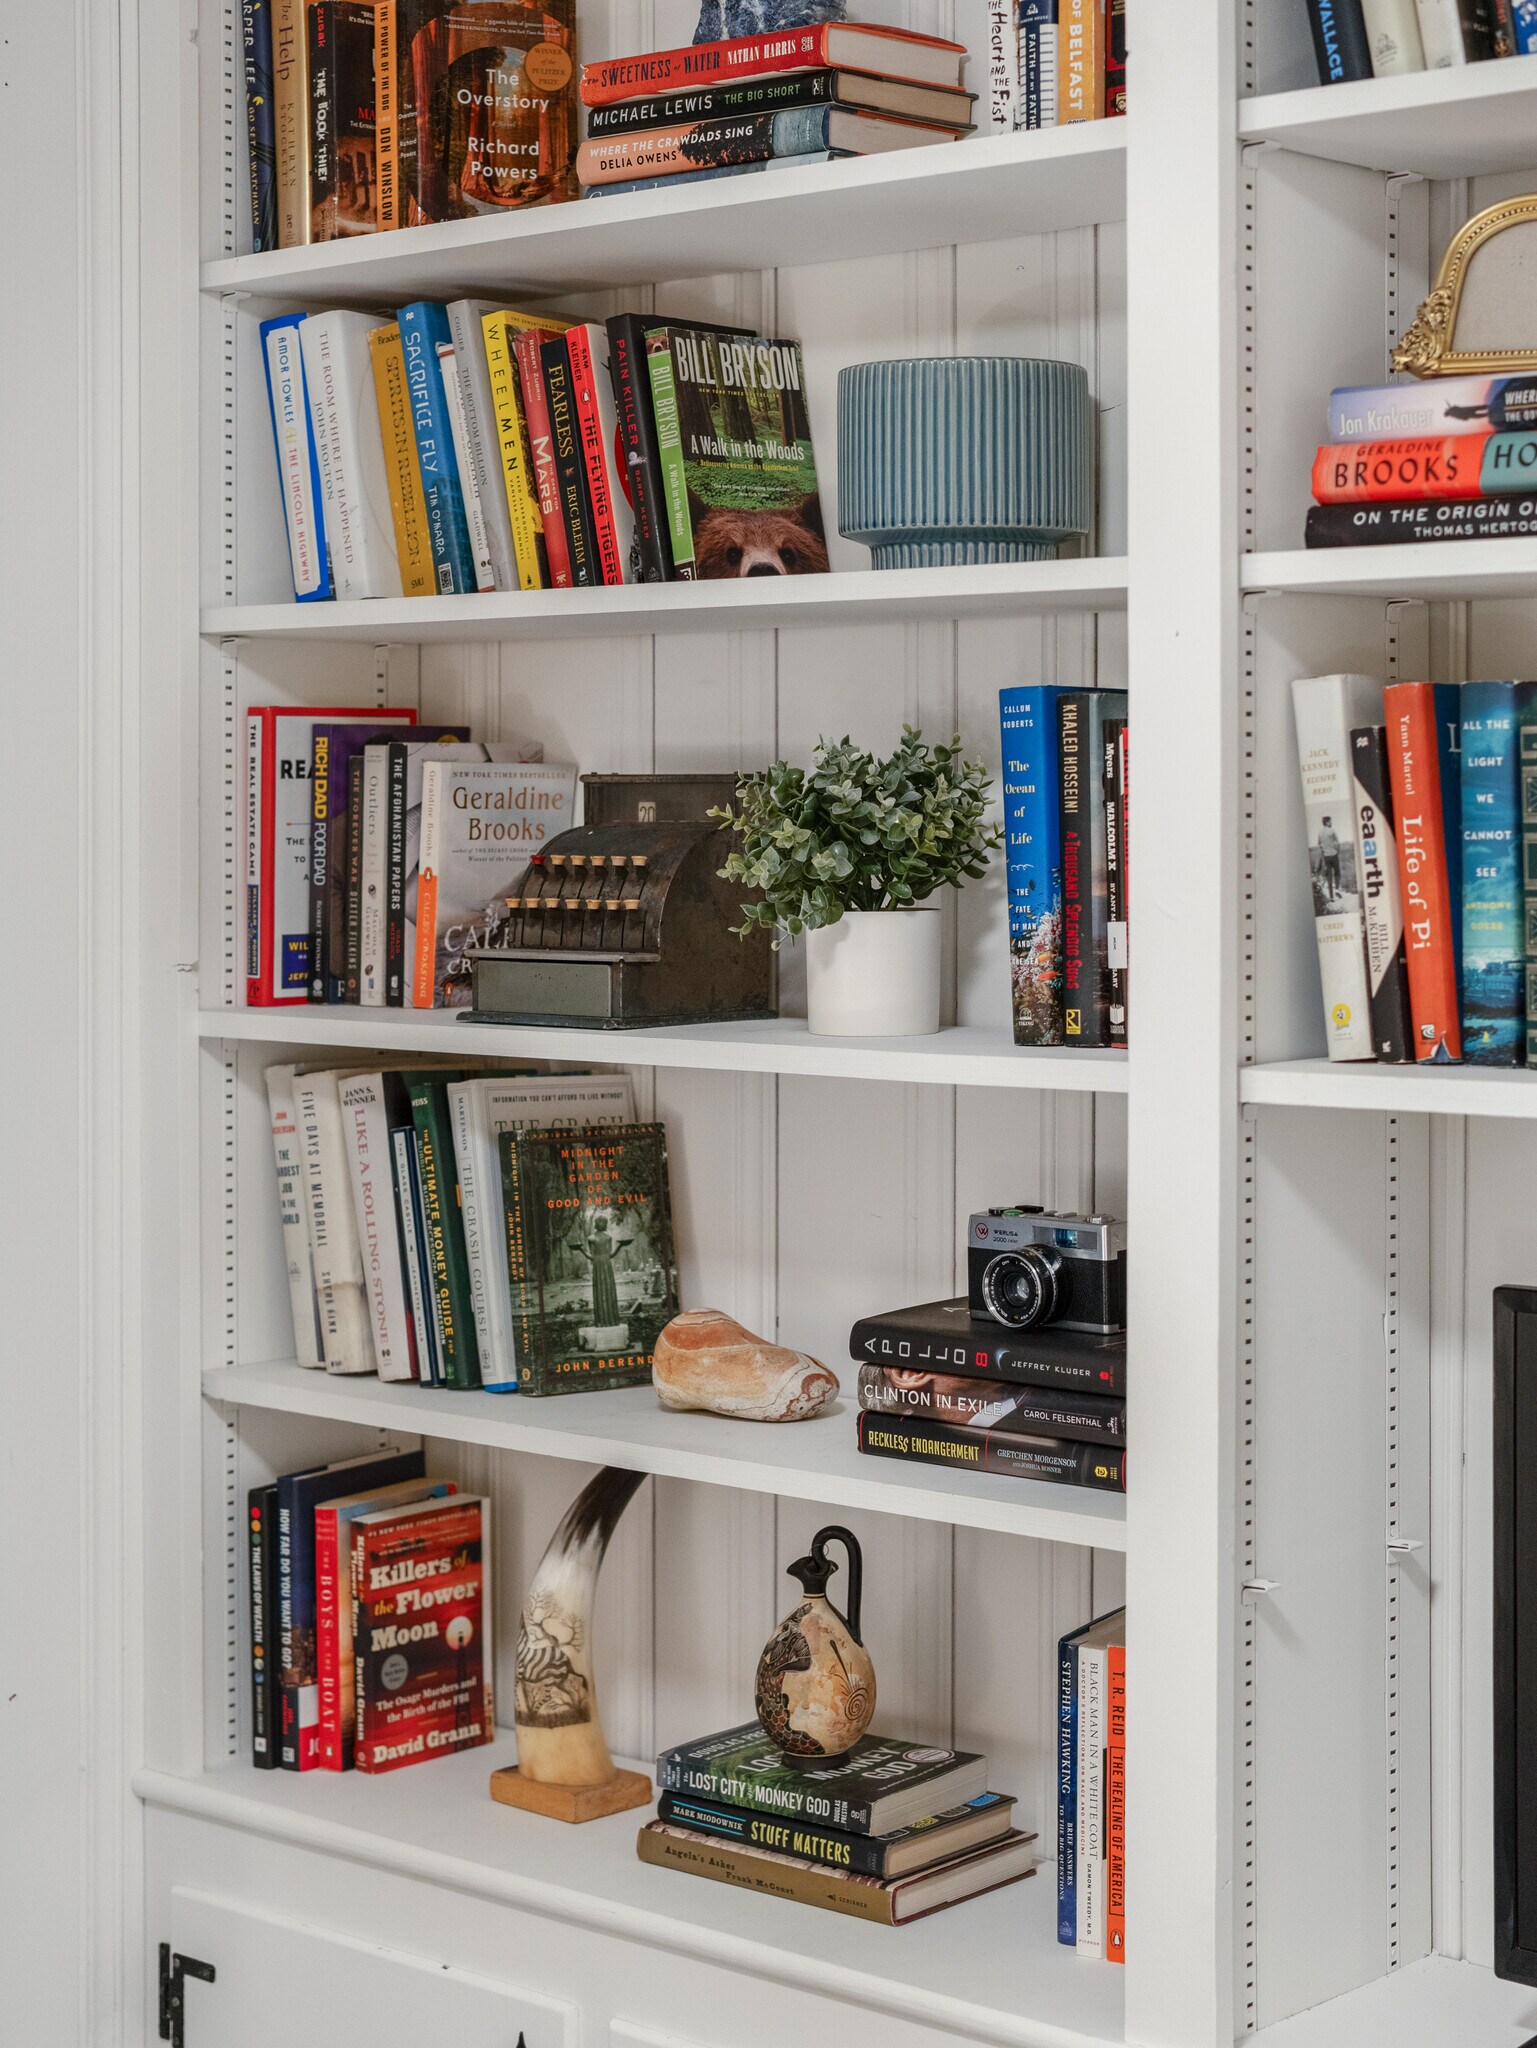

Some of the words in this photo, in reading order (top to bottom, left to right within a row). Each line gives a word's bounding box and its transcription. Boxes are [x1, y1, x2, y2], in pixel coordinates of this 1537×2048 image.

[276, 24, 296, 81] Help
[601, 58, 672, 88] SWEETNESS
[684, 51, 720, 74] WATER
[727, 46, 760, 66] NATHAN
[763, 40, 796, 58] HARRIS
[1070, 24, 1082, 110] BELFAST
[486, 68, 520, 85] The
[457, 89, 550, 113] Overstory
[593, 105, 658, 128] MICHAEL
[665, 95, 713, 116] LEWIS
[724, 93, 744, 105] THE
[747, 89, 764, 102] BIG
[767, 84, 800, 98] SHORT
[468, 136, 540, 156] Richard
[590, 142, 628, 158] WHERE
[632, 140, 654, 152] THE
[657, 130, 722, 149] CRAWDADS
[725, 126, 754, 140] SING
[471, 161, 538, 180] Powers
[600, 158, 633, 171] DELIA
[636, 151, 678, 166] OWENS
[250, 162, 260, 225] WATCHMAN
[278, 336, 290, 373] AMOR
[570, 342, 582, 381] KLEINER
[580, 348, 588, 368] SAM
[675, 336, 715, 385] BILL
[718, 342, 800, 390] BRYSON
[405, 332, 432, 430] SACRIFICE
[282, 378, 294, 423] TOWLES
[488, 324, 518, 472] WHEELMEN
[548, 364, 574, 458] FEARLESS
[584, 413, 598, 448] THE
[1339, 414, 1363, 436] Jon
[1368, 406, 1434, 432] Krakauer
[288, 448, 298, 467] THE
[420, 440, 438, 472] FLY
[691, 434, 698, 454] A
[700, 436, 728, 456] Walk
[730, 439, 742, 457] in
[744, 440, 764, 458] the
[765, 440, 805, 460] Woods
[1357, 441, 1443, 457] GERALDINE
[590, 455, 608, 516] FLYING
[1334, 456, 1458, 488] BROOKS
[291, 474, 304, 526] LINCOLN
[428, 486, 438, 507] TIM
[567, 486, 579, 516] ERIC
[1353, 512, 1381, 526] ON
[1390, 508, 1429, 522] THE
[1436, 502, 1510, 520] ORIGIN
[1414, 524, 1474, 538] THOMAS
[1480, 520, 1537, 534] HERTOG
[432, 510, 445, 556] O'MARA
[572, 518, 586, 564] BLEHM
[298, 532, 310, 582] HIGHWAY
[600, 522, 618, 584] TIGERS
[1003, 720, 1034, 728] ROBERTS
[1004, 704, 1031, 714] CALLUM
[1463, 721, 1482, 730] ALL
[1486, 719, 1510, 730] THE
[1062, 704, 1078, 753] KHALED
[1400, 715, 1410, 748] Yann
[315, 737, 328, 776] RICH
[394, 758, 402, 778] THE
[1008, 760, 1030, 772] The
[1468, 756, 1503, 767] LIGHT
[1005, 783, 1036, 794] Ocean
[1064, 758, 1079, 814] HOSSEINI
[1402, 751, 1415, 796] Martel
[315, 780, 328, 819] DAD
[453, 786, 564, 810] Geraldine
[1014, 806, 1026, 818] of
[1476, 794, 1494, 804] WE
[314, 822, 326, 856] POOR
[392, 784, 402, 862] AFGHANISTAN
[468, 817, 546, 840] Brooks
[1010, 832, 1032, 845] Life
[1464, 830, 1512, 840] CANNOT
[1360, 805, 1384, 898] eaarth
[1403, 815, 1426, 873] Life
[314, 858, 326, 886] DAD
[1064, 841, 1080, 899] THOUSAND
[1476, 868, 1497, 878] SEE
[392, 867, 400, 910] PAPERS
[1408, 881, 1427, 910] of
[1065, 904, 1082, 957] SPLENDID
[1412, 918, 1431, 949] Pi
[1066, 960, 1082, 990] SUNS
[558, 1094, 578, 1102] AFFORD
[601, 1092, 622, 1100] WITHOUT
[562, 1146, 624, 1158] MIDNIGHT
[572, 1162, 584, 1170] IN
[592, 1158, 614, 1168] THE
[568, 1172, 620, 1182] GARDEN
[587, 1185, 602, 1194] OF
[548, 1199, 580, 1208] GOOD
[587, 1196, 610, 1206] AND
[618, 1193, 648, 1204] EVIL
[433, 1226, 448, 1280] MONEY
[993, 1236, 1007, 1244] 2000
[440, 1288, 454, 1336] GUIDE
[556, 1362, 590, 1373] JOHN
[864, 1336, 966, 1366] APOLLO
[976, 1352, 988, 1367] 8
[1012, 1360, 1050, 1371] JEFFREY
[1054, 1366, 1091, 1377] KLUGER
[864, 1384, 930, 1408] CLINTON
[936, 1394, 952, 1408] IN
[957, 1397, 1002, 1416] EXILE
[1024, 1409, 1050, 1421] CAROL
[1052, 1412, 1102, 1428] FELSENTHAL
[911, 1436, 980, 1462] ENDANGERMENT
[997, 1449, 1033, 1462] GRETCHEN
[1034, 1453, 1077, 1467] MORGENSON
[370, 1557, 452, 1590] Killers
[454, 1550, 468, 1568] of
[374, 1601, 394, 1616] the
[396, 1582, 478, 1616] Flower
[370, 1621, 438, 1652] Moon
[1062, 1661, 1072, 1722] STEPHEN
[1090, 1662, 1098, 1704] BLACK
[1090, 1708, 1098, 1738] MAN
[1112, 1705, 1124, 1736] REID
[373, 1732, 424, 1764] David
[426, 1722, 482, 1748] Grann
[1090, 1744, 1098, 1758] IN
[1061, 1728, 1071, 1794] HAWKING
[1112, 1756, 1123, 1776] THE
[689, 1771, 717, 1792] LOST
[720, 1777, 746, 1798] CITY
[755, 1785, 803, 1810] MONKEY
[806, 1796, 830, 1816] GOD
[1089, 1774, 1098, 1820] WHITE
[1112, 1781, 1122, 1831] HEALING
[672, 1806, 695, 1818] MARK
[696, 1810, 743, 1830] MIODOWNIK
[751, 1820, 790, 1846] STUFF
[793, 1831, 850, 1864] MATTERS
[1089, 1822, 1098, 1860] COAT
[1112, 1834, 1122, 1851] OF
[664, 1846, 704, 1862] Angela's
[708, 1857, 736, 1870] Ashes
[726, 1871, 752, 1884] Frank
[756, 1879, 794, 1894] McCourt
[1112, 1855, 1122, 1908] AMERICA
